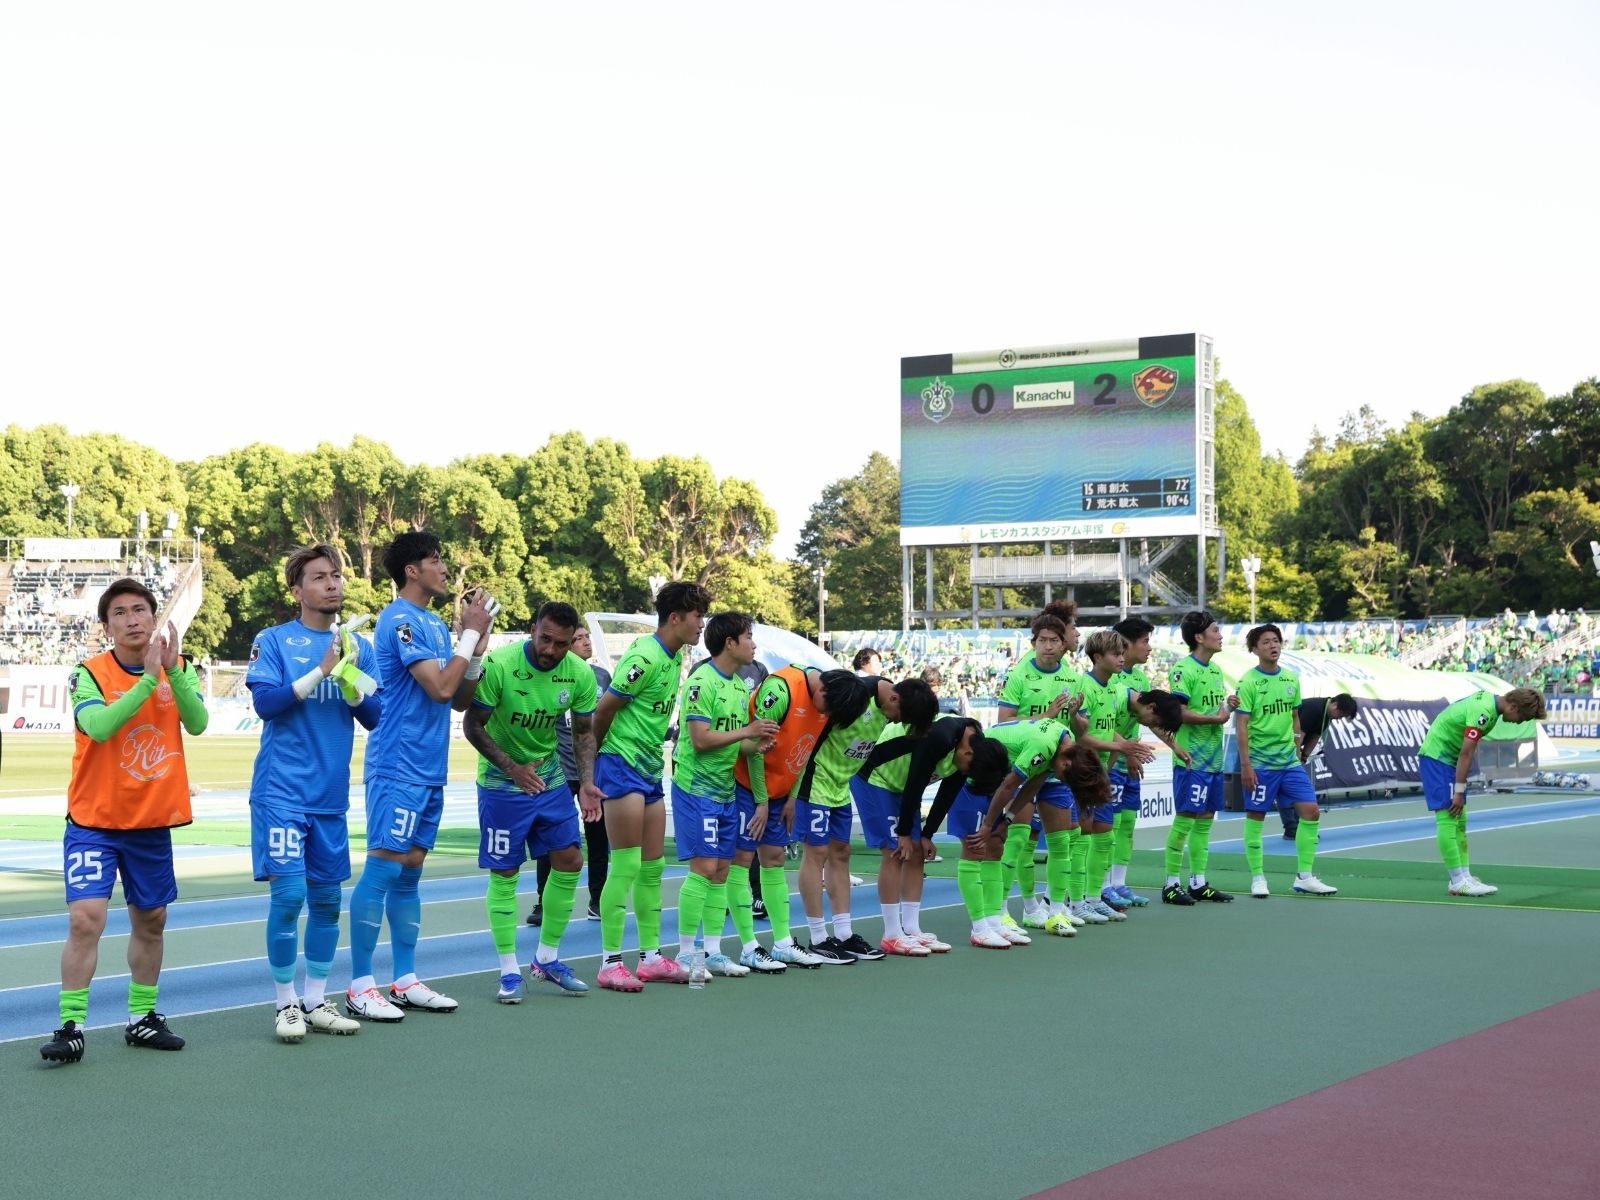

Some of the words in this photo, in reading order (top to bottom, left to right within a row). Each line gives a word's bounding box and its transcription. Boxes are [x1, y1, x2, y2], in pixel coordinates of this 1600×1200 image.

[971, 383, 995, 414] 0
[1016, 389, 1072, 403] Kanachu
[1093, 373, 1117, 405] 2
[1084, 483, 1094, 495] 15
[1097, 483, 1107, 494] 南
[1086, 498, 1092, 510] 7
[1097, 498, 1117, 509] 荒木
[1545, 699, 1600, 722] IDRO
[1547, 725, 1598, 737] SEMPRE
[1352, 754, 1397, 775] ESTATE
[1190, 784, 1208, 803] 34
[1251, 785, 1266, 802] 13
[391, 808, 417, 838] 31
[269, 827, 301, 857] 99
[487, 827, 511, 855] 16
[67, 851, 102, 884] 25
